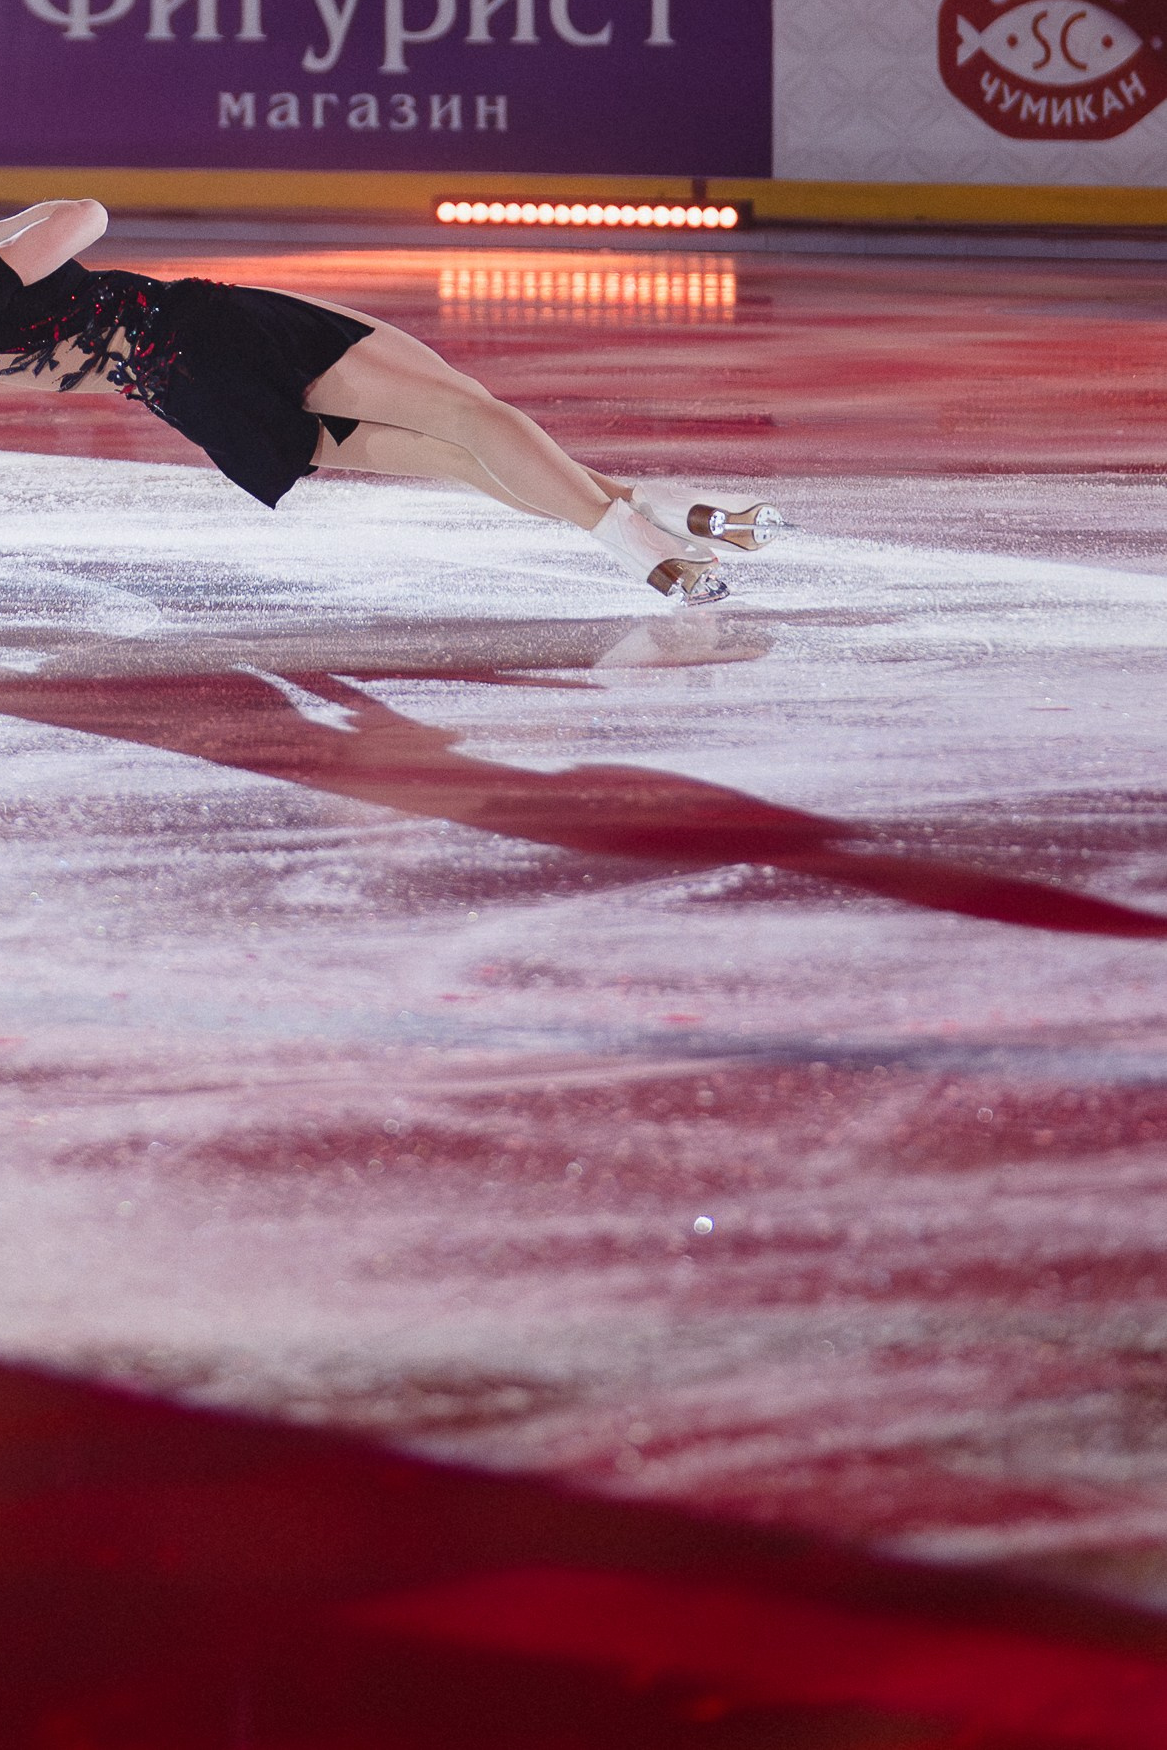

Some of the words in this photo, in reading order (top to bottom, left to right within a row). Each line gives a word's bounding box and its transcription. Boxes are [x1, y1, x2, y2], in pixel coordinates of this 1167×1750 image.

[1032, 9, 1088, 71] SC
[218, 92, 508, 131] магазин
[980, 70, 1147, 126] ЧУМИКАН
